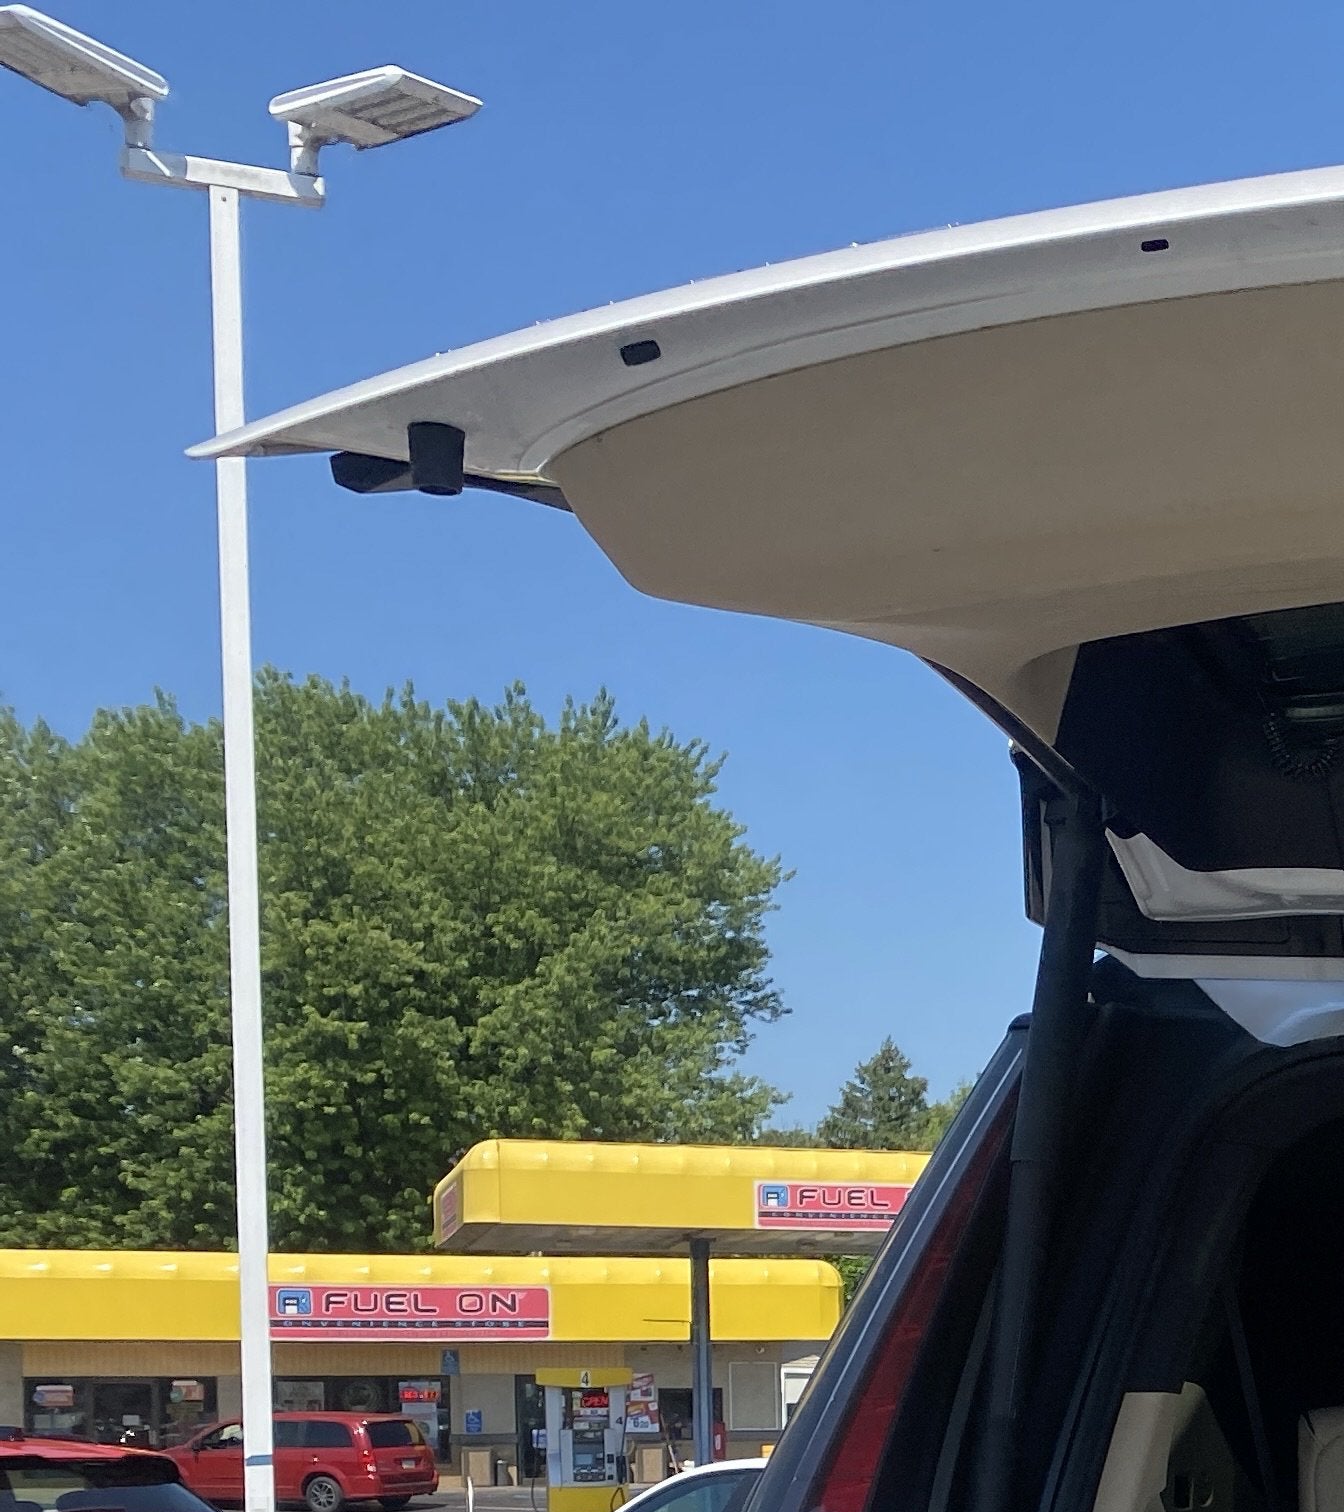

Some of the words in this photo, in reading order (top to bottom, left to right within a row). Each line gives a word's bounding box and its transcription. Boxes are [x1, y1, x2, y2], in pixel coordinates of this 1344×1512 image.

[798, 1188, 890, 1207] FUEL
[324, 1292, 438, 1313] FUEL
[457, 1292, 519, 1313] ON
[283, 1319, 439, 1328] ONVENIENCE
[581, 1372, 590, 1386] 4
[615, 1416, 623, 1425] 4
